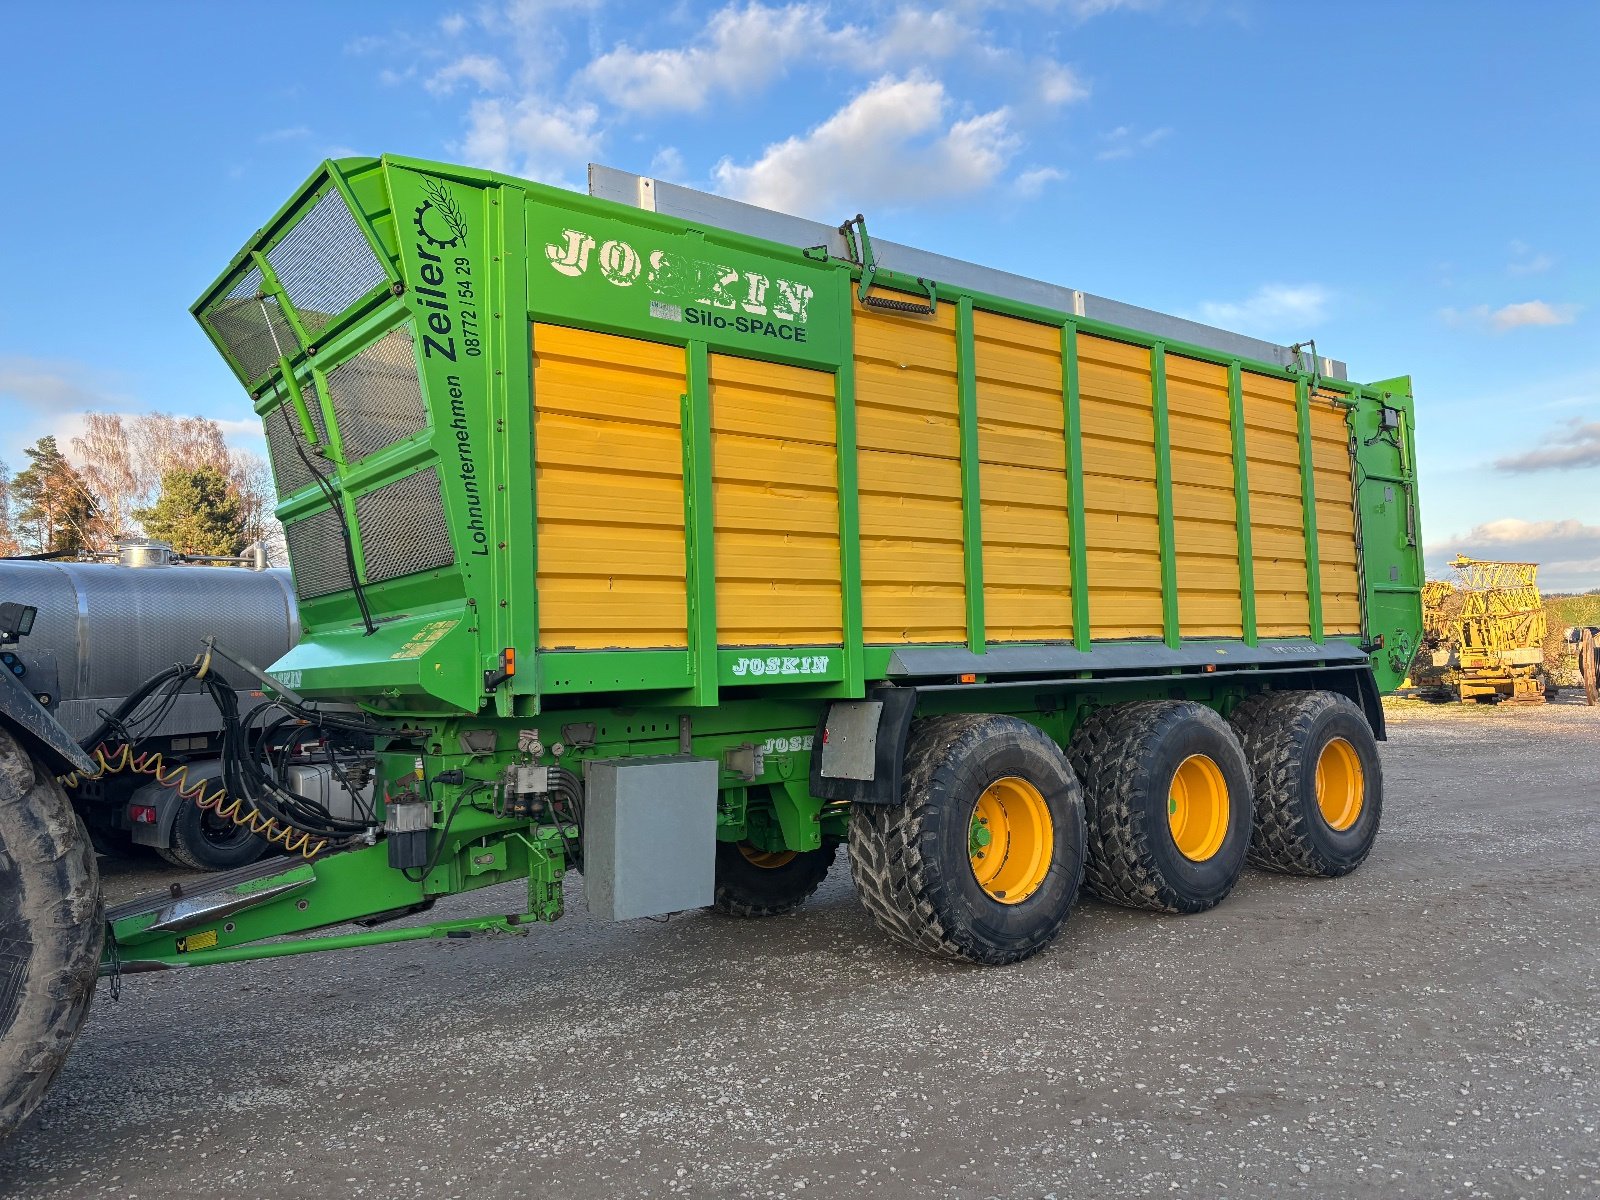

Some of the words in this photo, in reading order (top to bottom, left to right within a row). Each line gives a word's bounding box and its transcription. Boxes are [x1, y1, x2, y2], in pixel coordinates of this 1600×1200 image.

[415, 243, 457, 362] Zeiler
[545, 228, 813, 323] JOIN
[684, 307, 807, 343] Silo-SPACE
[446, 375, 489, 556] Lohnunternehmen
[732, 655, 829, 676] JOSKIN
